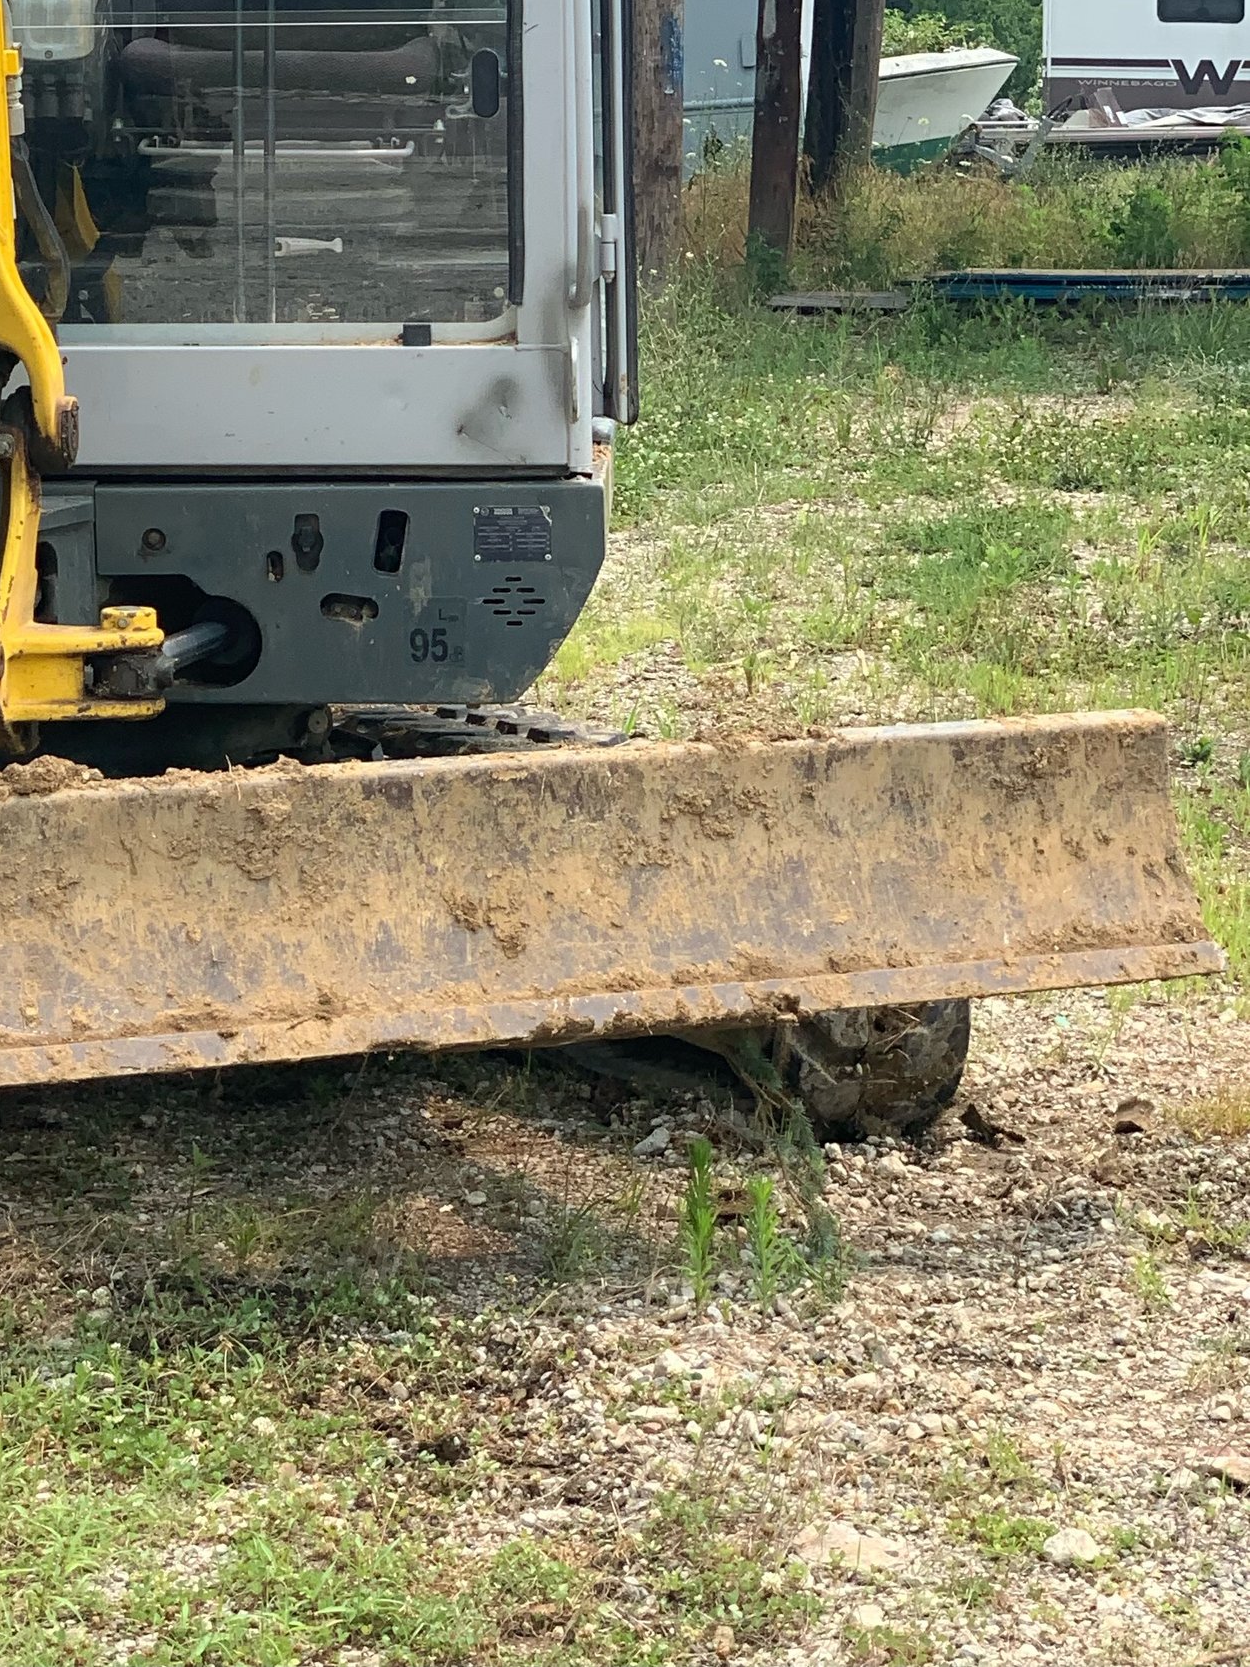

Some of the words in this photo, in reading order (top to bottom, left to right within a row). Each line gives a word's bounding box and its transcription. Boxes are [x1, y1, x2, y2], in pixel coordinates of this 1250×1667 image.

[1078, 79, 1177, 87] WINNEBAGO
[1170, 59, 1242, 95] W
[410, 628, 448, 662] 95
